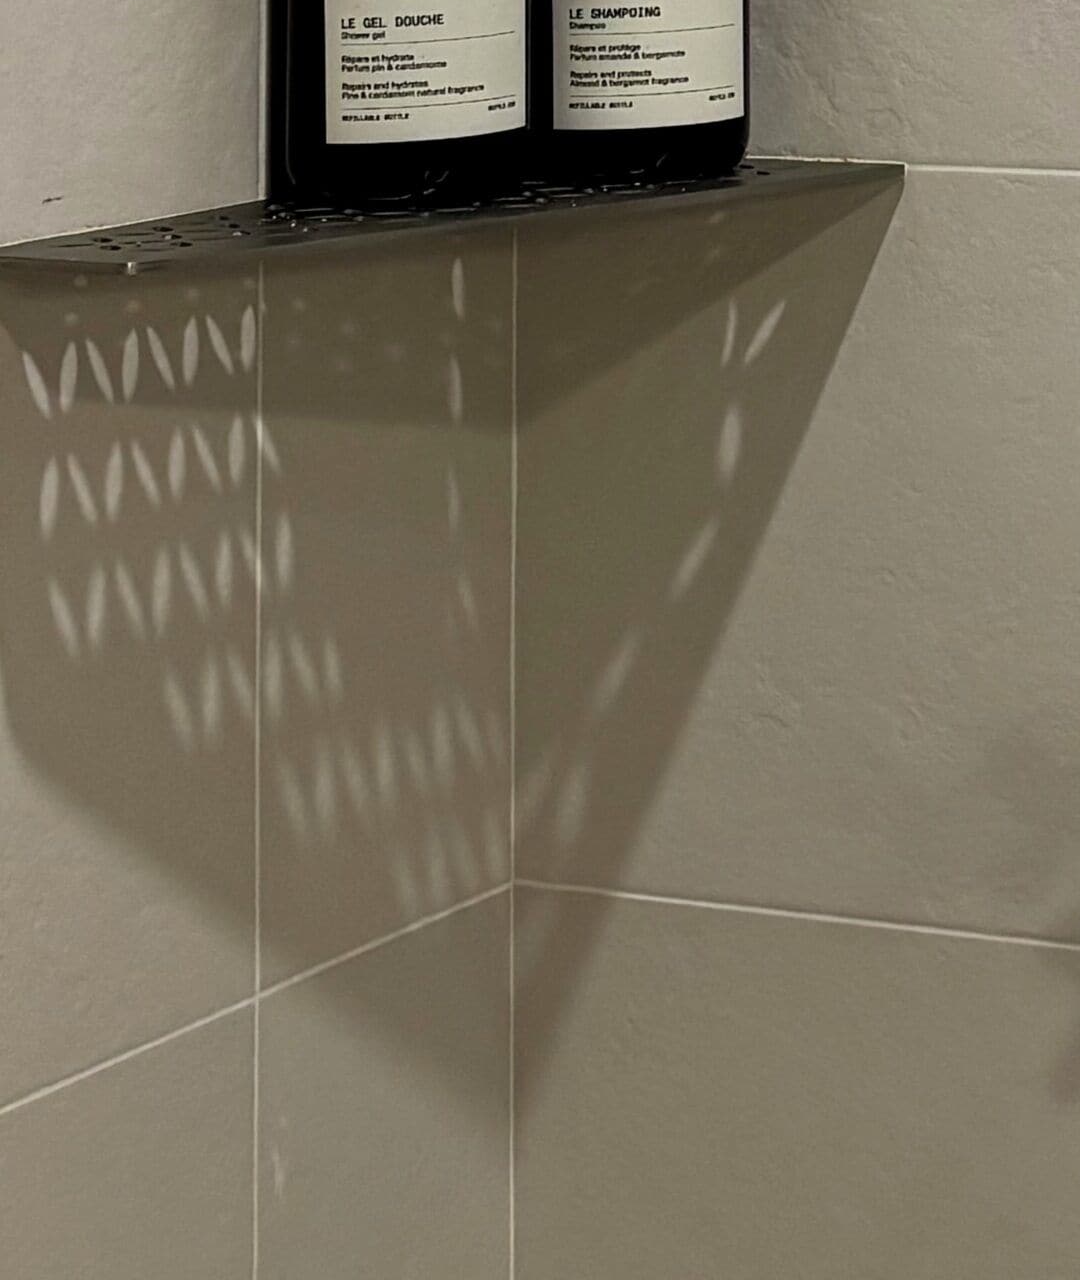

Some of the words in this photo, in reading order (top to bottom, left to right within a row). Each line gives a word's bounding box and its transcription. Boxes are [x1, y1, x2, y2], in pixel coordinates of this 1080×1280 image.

[569, 9, 583, 19] LE
[591, 7, 661, 19] SHAMPOING
[341, 18, 356, 29] LE
[363, 17, 387, 29] GEL
[395, 14, 444, 27] DOUCHE
[569, 22, 606, 31] Shampoo
[341, 31, 370, 40] Shower
[372, 30, 386, 40] gel
[598, 44, 606, 52] et
[634, 51, 641, 59] &
[600, 70, 616, 78] and
[373, 81, 389, 90] and
[570, 79, 600, 88] Almond
[601, 78, 608, 87] &
[651, 76, 689, 86] fragrance
[448, 84, 485, 95] fragrance
